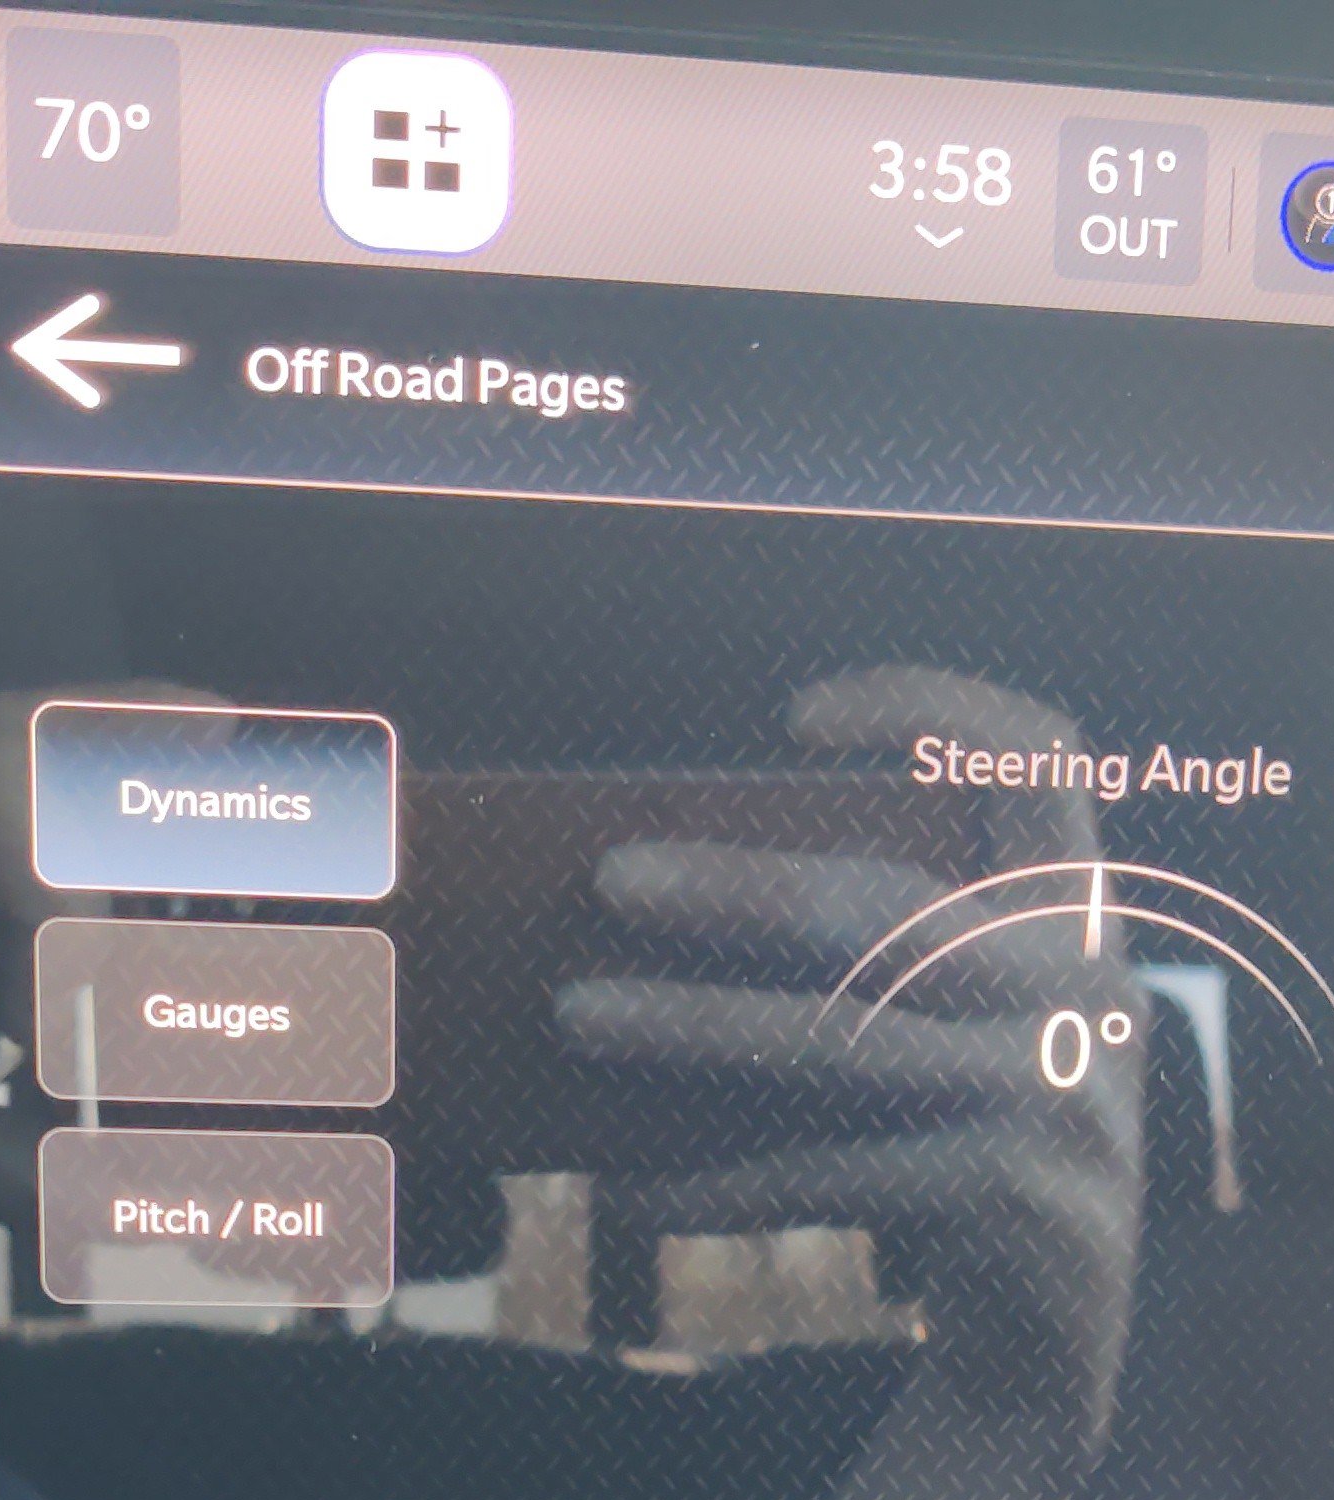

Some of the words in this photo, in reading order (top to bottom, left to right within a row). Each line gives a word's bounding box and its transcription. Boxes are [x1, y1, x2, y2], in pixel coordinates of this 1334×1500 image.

[33, 96, 151, 163] 70°
[868, 139, 1013, 206] 3:58
[1086, 145, 1177, 197] 61°
[1079, 214, 1179, 260] OUT
[247, 346, 331, 395] Off
[338, 350, 464, 403] Road
[478, 358, 626, 418] Pages
[911, 735, 1130, 801] Steering
[1140, 744, 1293, 804] Angle
[120, 779, 312, 824] Dynamics
[143, 994, 291, 1038] Gauges
[1040, 1010, 1133, 1089] 0°
[113, 1198, 210, 1235] Pitch
[253, 1201, 324, 1237] Roll
